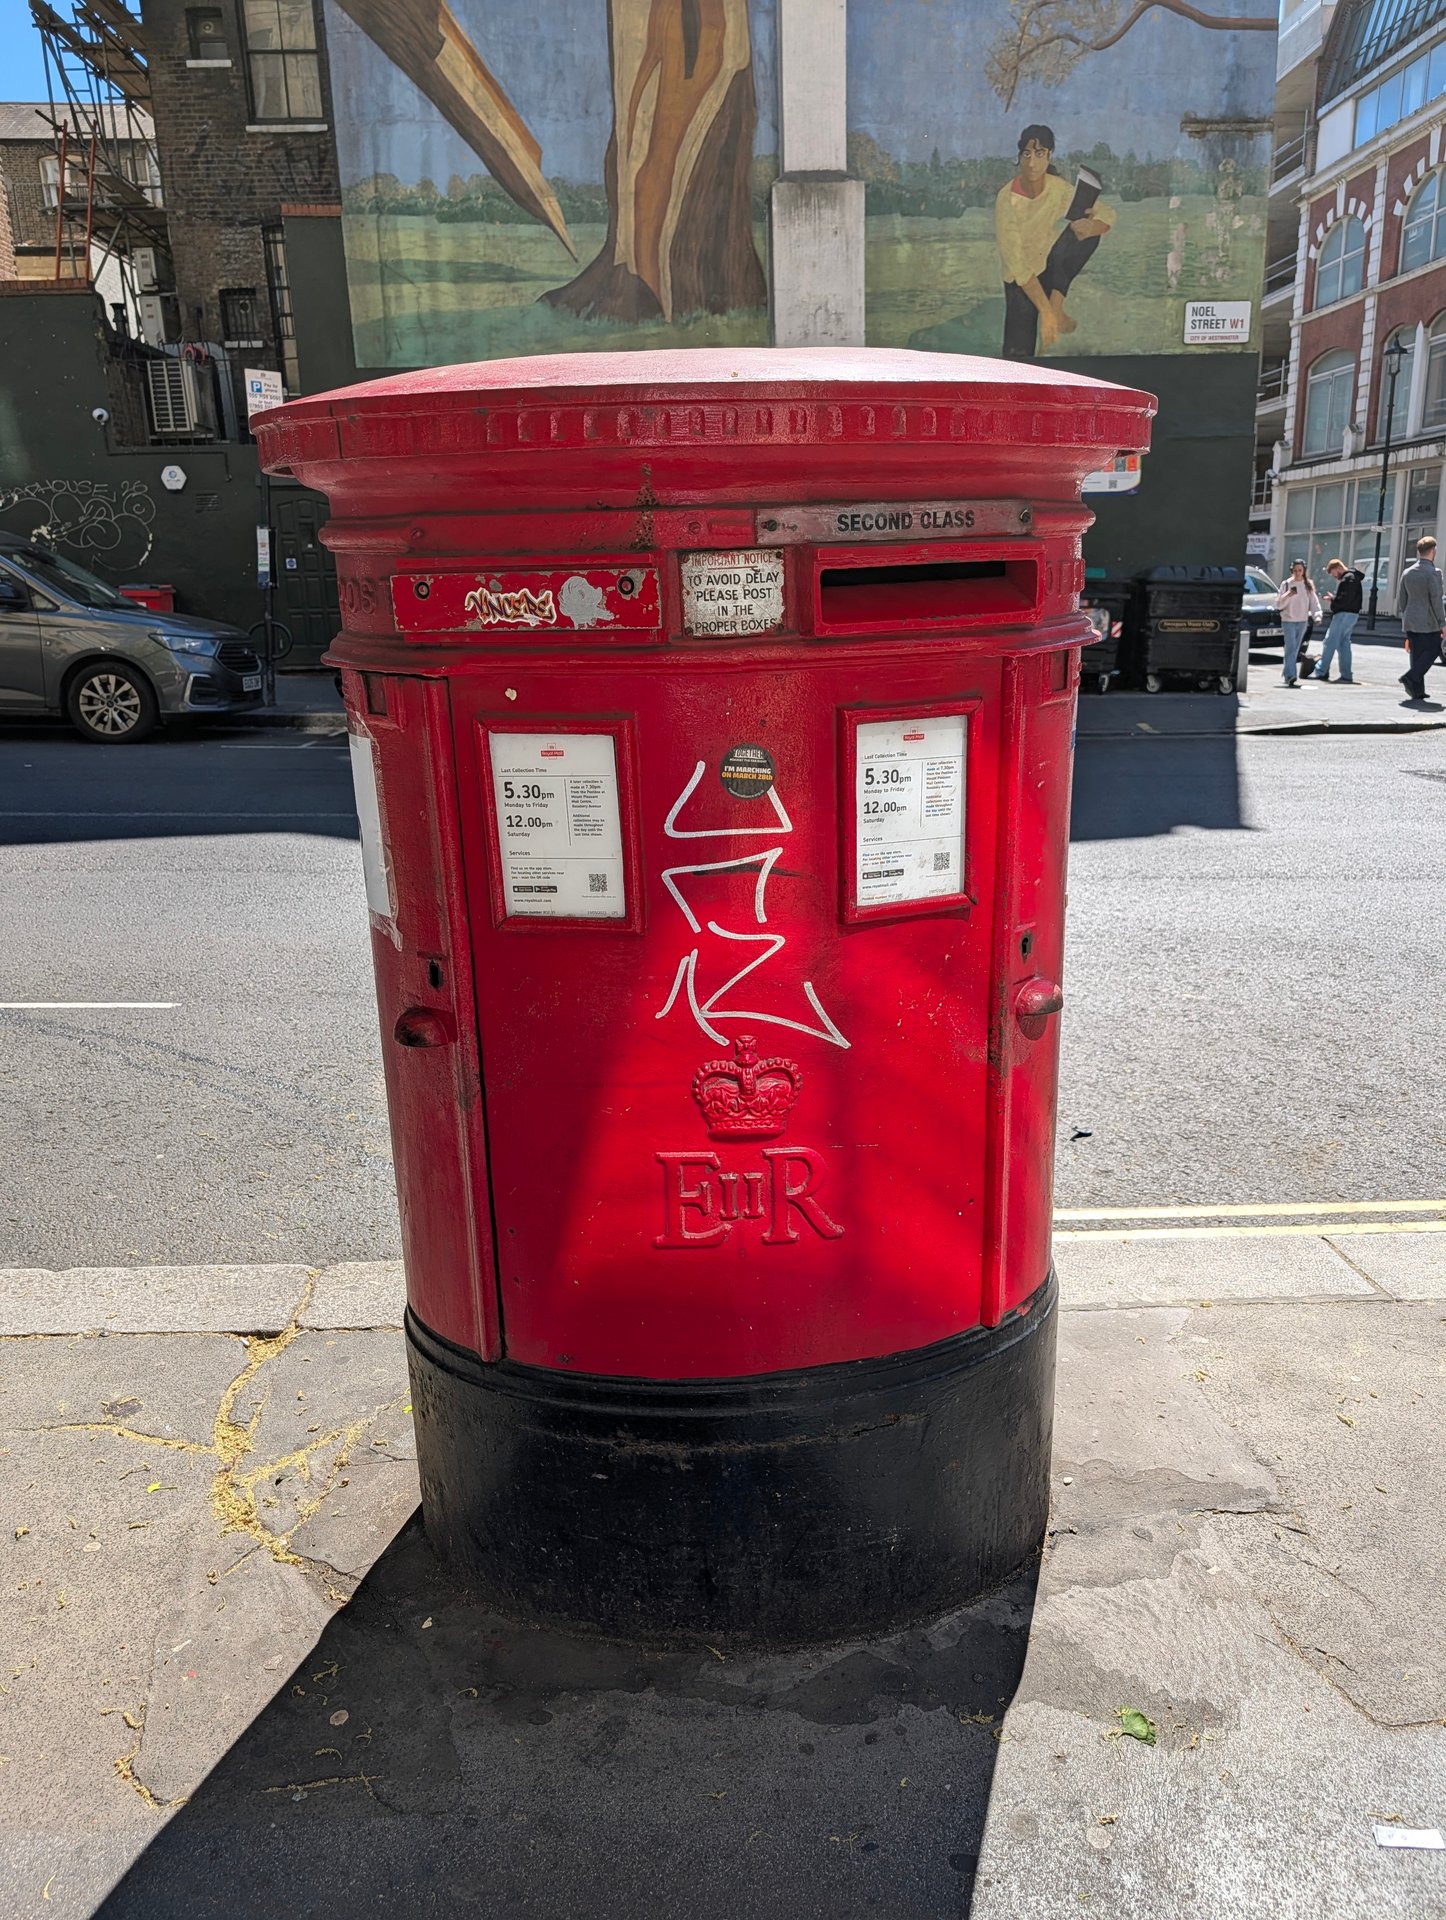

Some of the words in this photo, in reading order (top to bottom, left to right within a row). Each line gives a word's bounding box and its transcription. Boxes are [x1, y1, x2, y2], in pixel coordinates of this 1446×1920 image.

[1192, 306, 1216, 316] NOEL
[1191, 318, 1227, 329] STREET
[1230, 318, 1244, 329] W1
[838, 512, 913, 532] SECOND
[920, 510, 975, 529] CLASS
[692, 552, 741, 566] IMPORTANT
[744, 552, 773, 565] NOTICE
[687, 574, 702, 587] TO
[706, 574, 740, 585] AVOID
[746, 572, 779, 583] DELAY
[696, 590, 738, 601] PLEASE
[744, 588, 772, 599] POST
[718, 606, 728, 616] IN
[733, 604, 754, 615] THE
[695, 621, 737, 633] PROPER
[741, 618, 777, 631] BOXES
[865, 768, 911, 785] 5.30pm
[504, 781, 554, 800] 5.30pm
[864, 801, 907, 814] 12.00pm
[506, 815, 553, 828] 12.00pm
